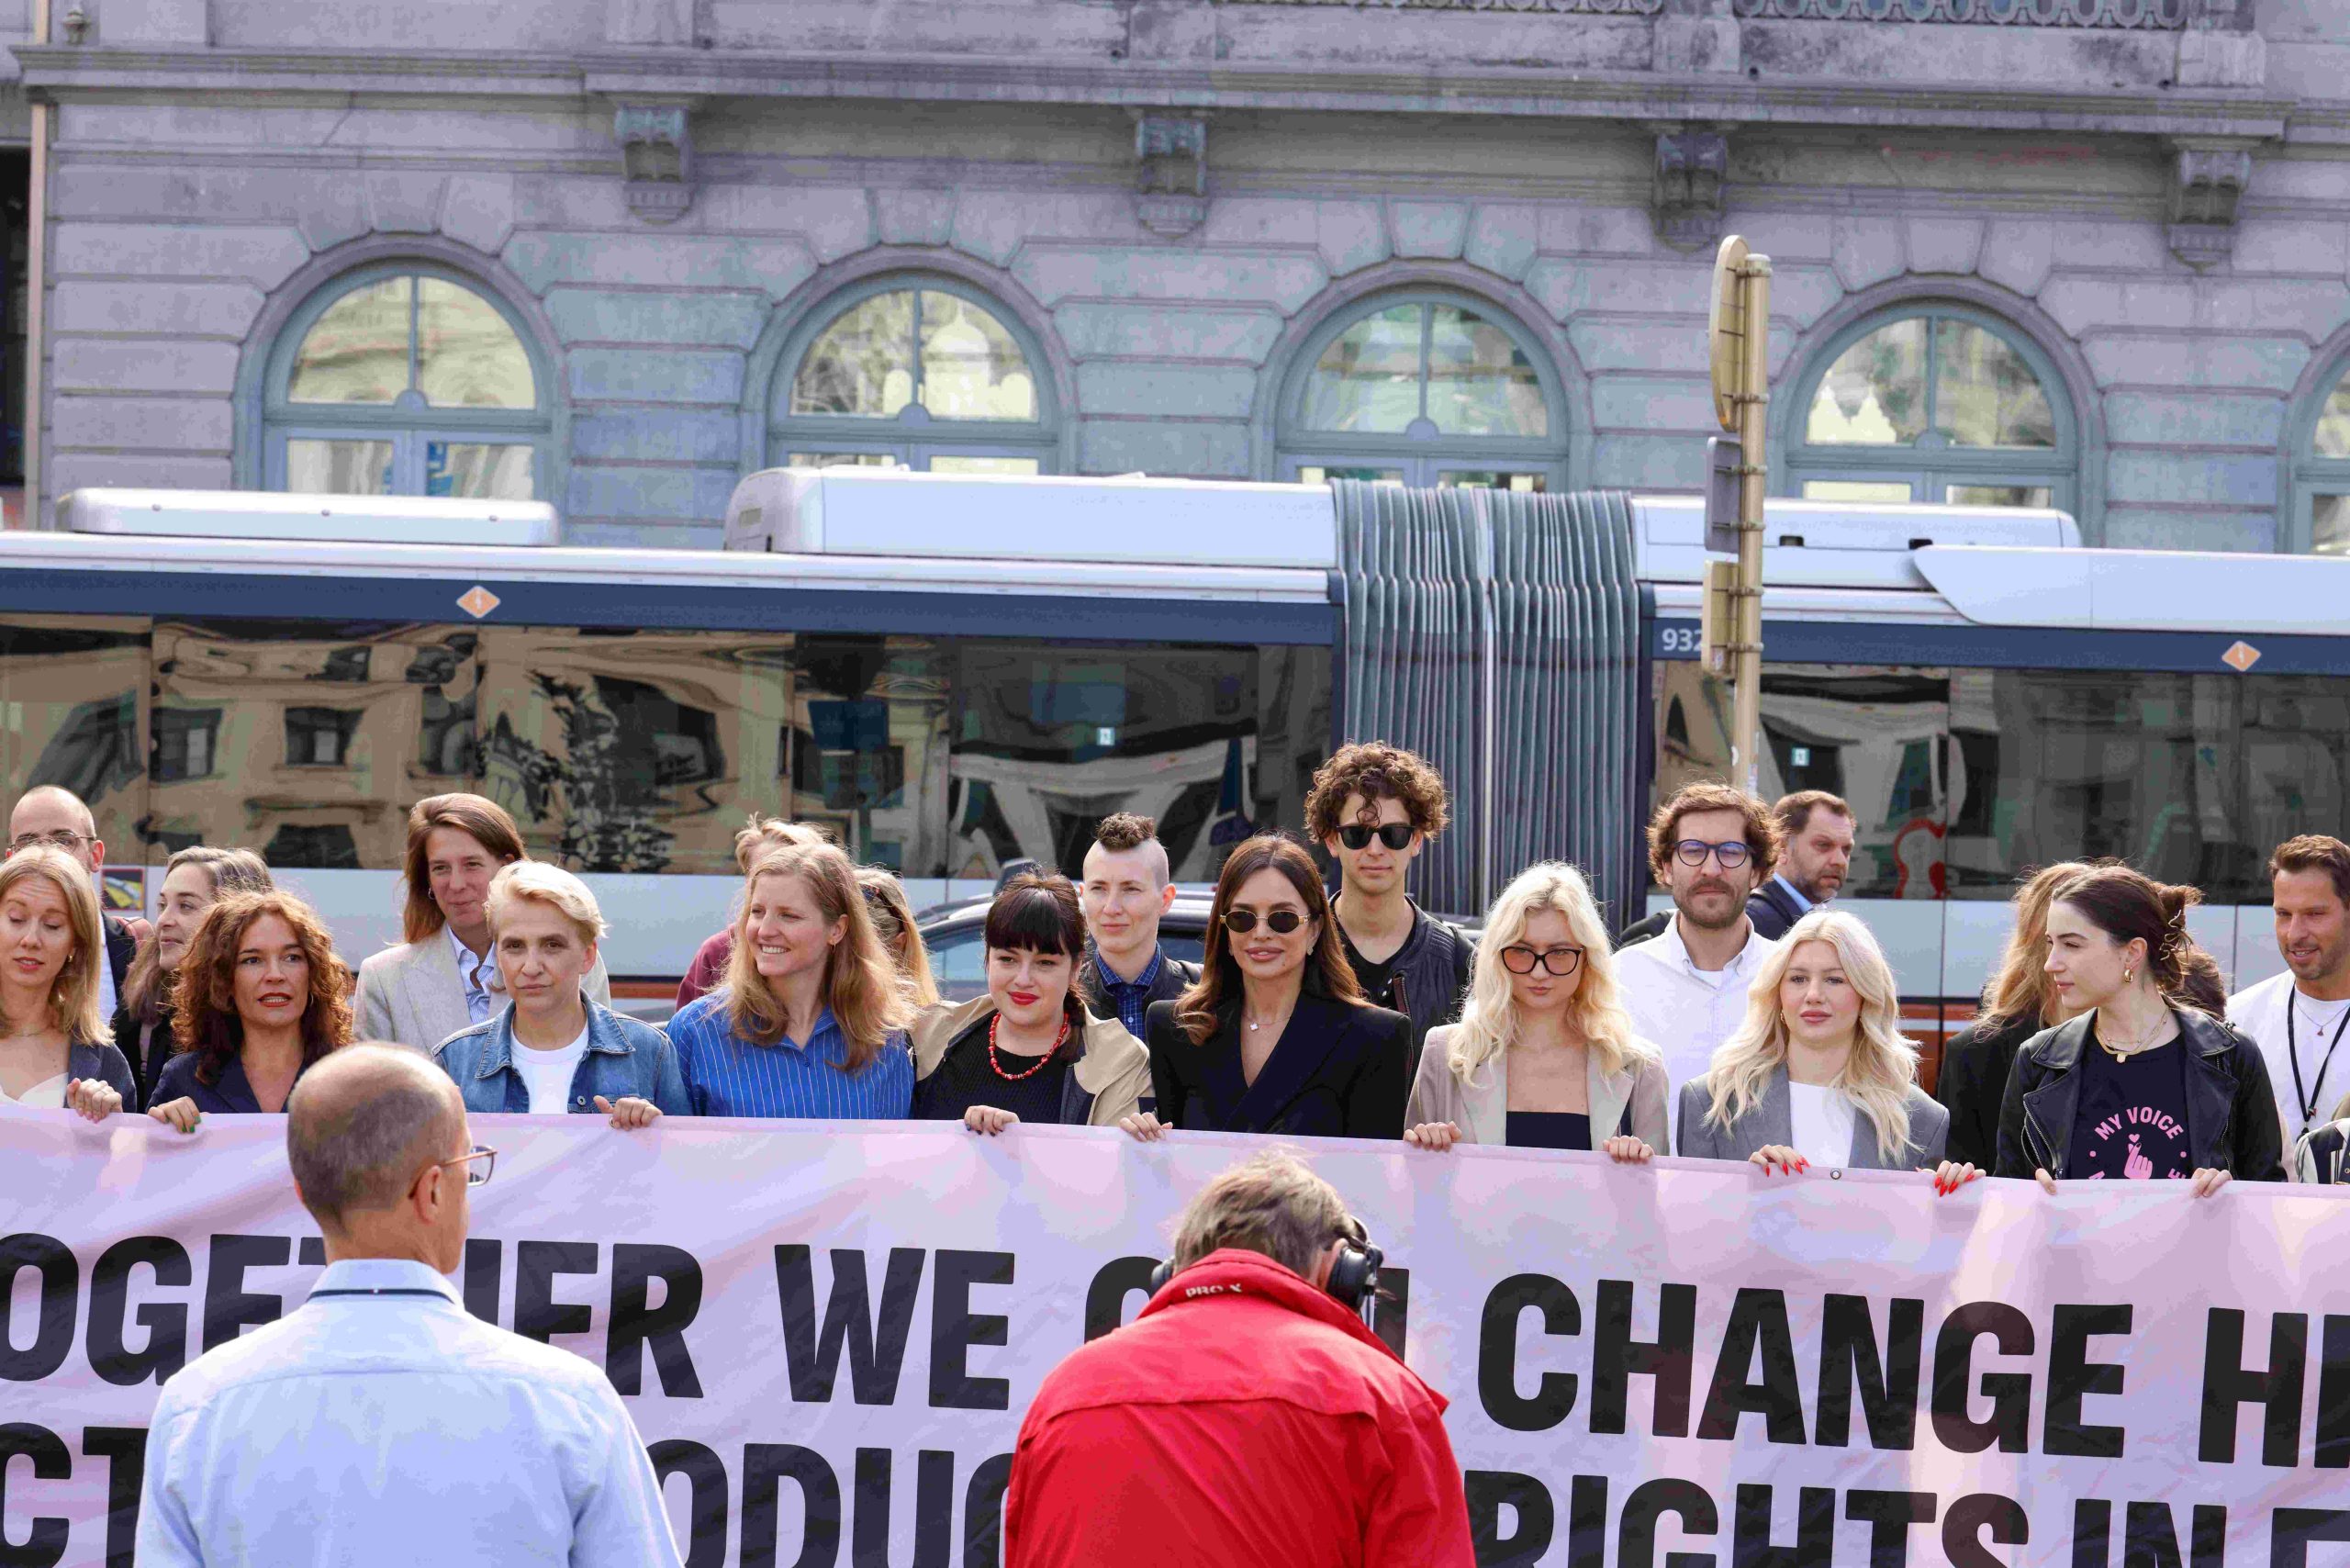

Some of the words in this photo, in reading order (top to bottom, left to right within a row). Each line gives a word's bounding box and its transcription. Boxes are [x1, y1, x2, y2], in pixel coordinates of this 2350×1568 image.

[2095, 1113, 2122, 1141] MY
[2126, 1106, 2184, 1140] VOICE
[0, 1232, 704, 1399] OGEER
[775, 1244, 1015, 1411] WE
[1477, 1272, 2133, 1459] CHANGE
